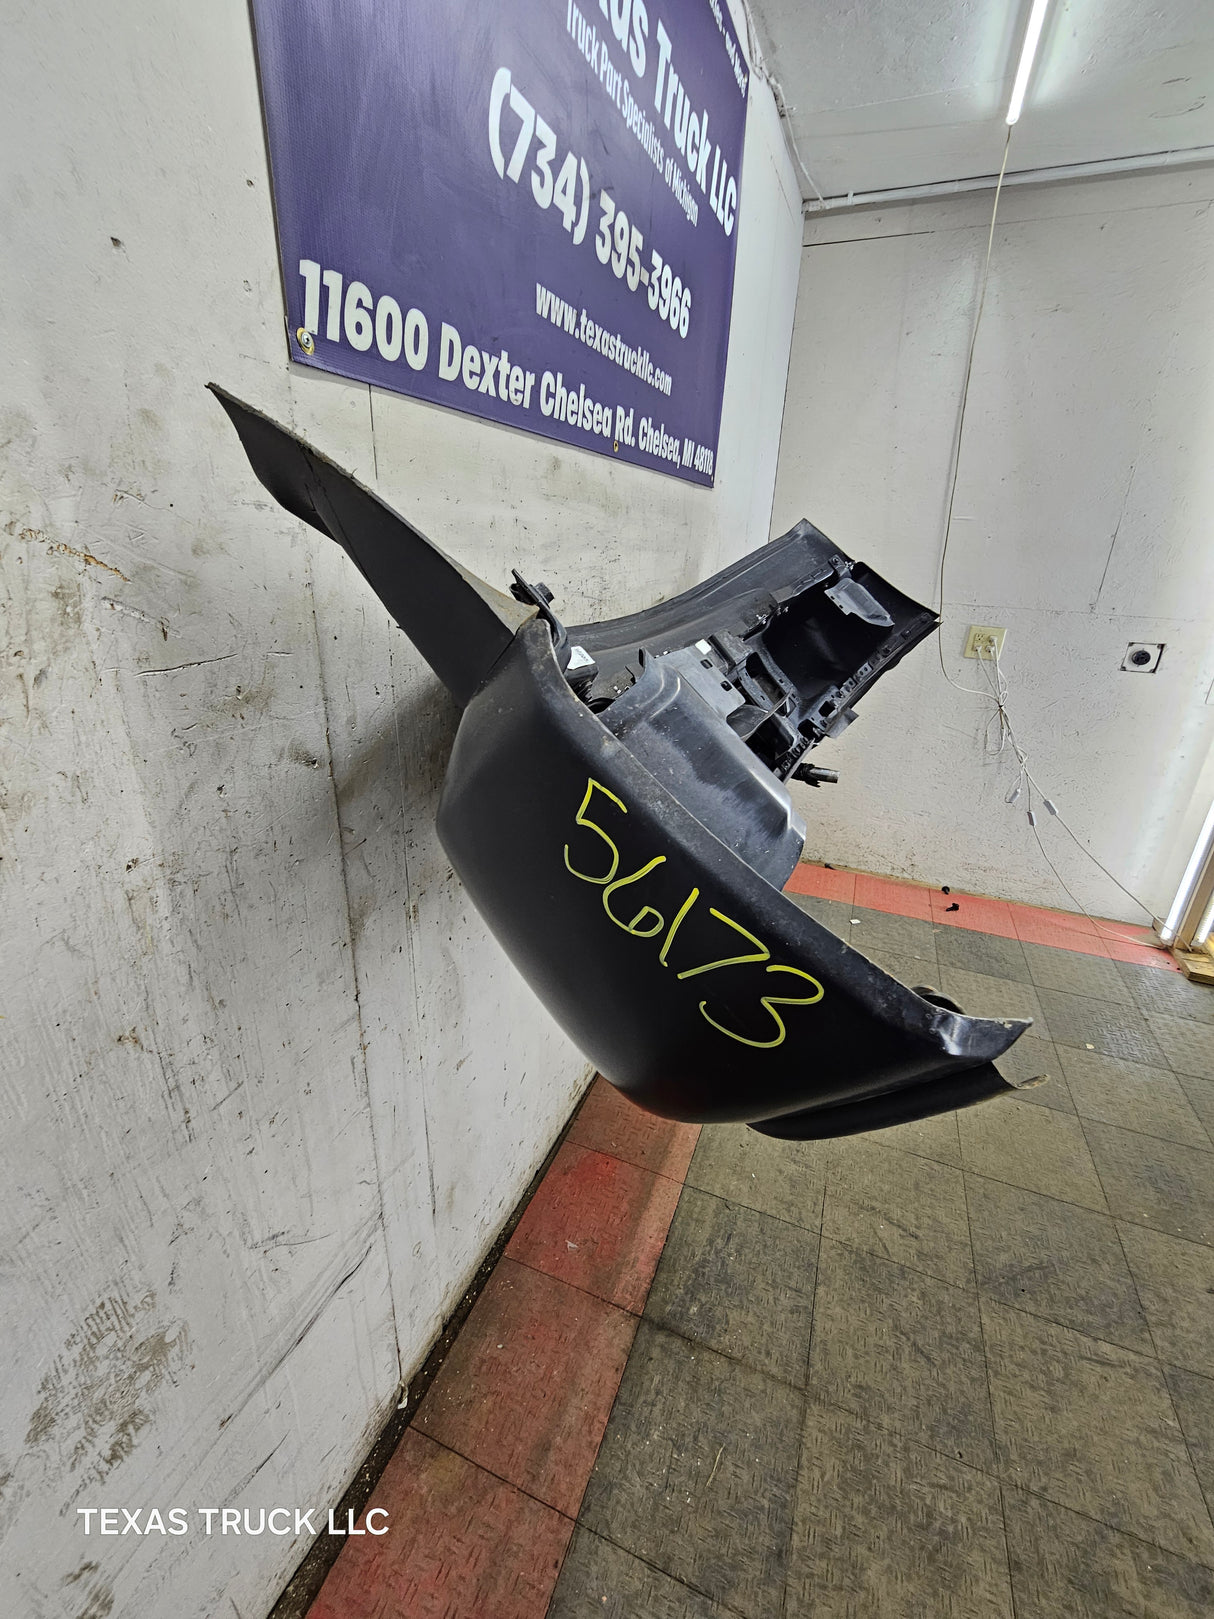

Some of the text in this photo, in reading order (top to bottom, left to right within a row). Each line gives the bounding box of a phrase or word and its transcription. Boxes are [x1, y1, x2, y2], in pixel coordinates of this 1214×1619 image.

[488, 66, 692, 339] (734) 395-3966
[600, 40, 622, 110] Part
[622, 79, 665, 174] Specialists
[664, 157, 674, 188] of
[671, 162, 699, 228] Michigan
[654, 17, 712, 195] Truck
[709, 144, 737, 236] LLC
[299, 259, 715, 476] 11600 Dexter Chelsea Rd. Chelsea, MI 48118
[535, 282, 673, 396] www.texastruckllc.com
[563, 777, 825, 1049] 56173
